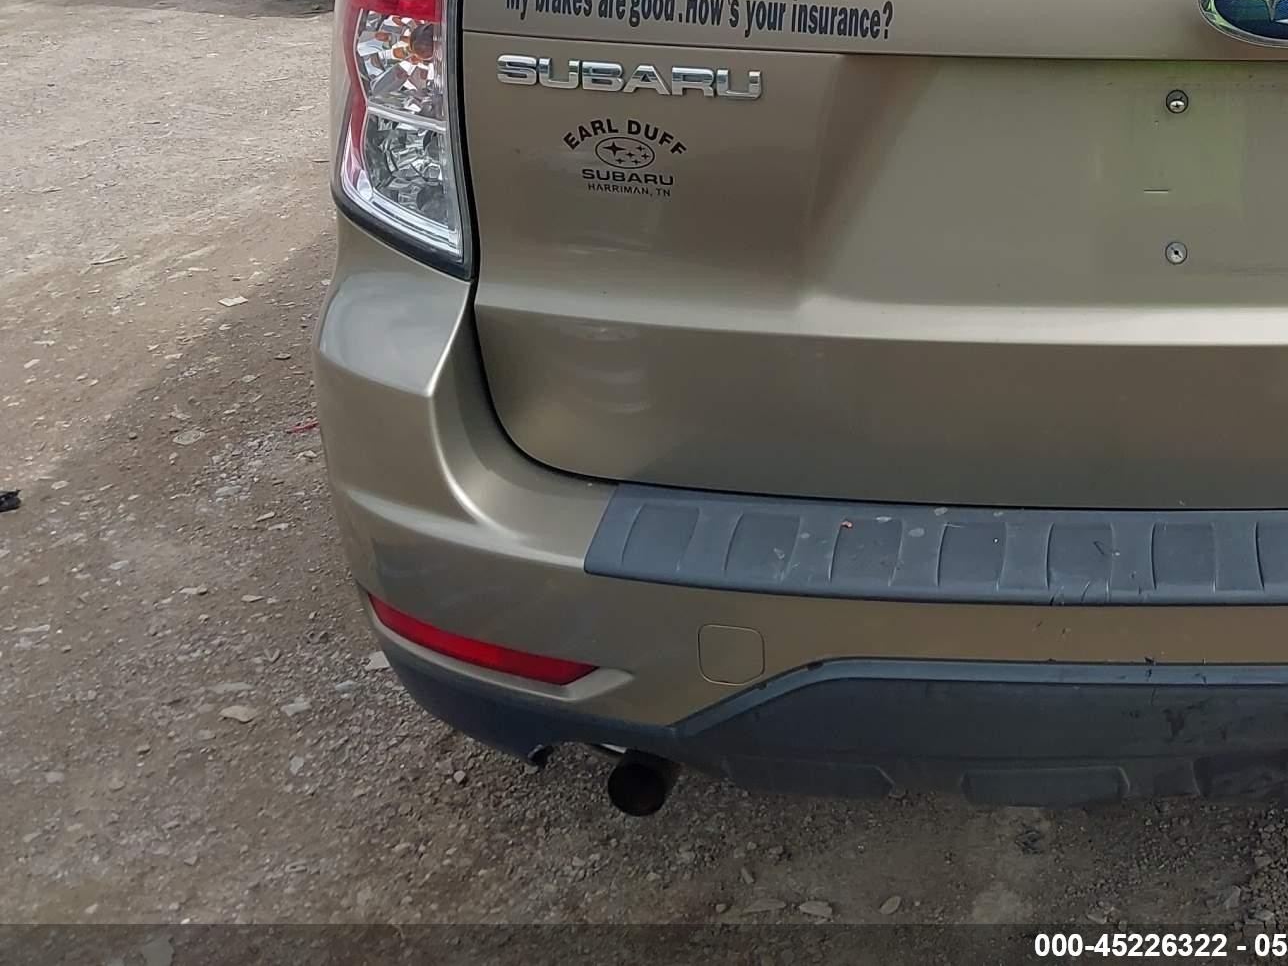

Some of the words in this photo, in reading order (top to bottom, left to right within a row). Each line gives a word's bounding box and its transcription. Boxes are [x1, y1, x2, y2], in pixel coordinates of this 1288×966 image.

[744, 0, 787, 38] your
[497, 53, 763, 100] SUBARU
[563, 118, 619, 150] EARL
[627, 119, 687, 155] DUFF
[581, 168, 674, 186] SUBARU
[588, 182, 654, 197] HARRIMAN,
[656, 187, 671, 197] TN
